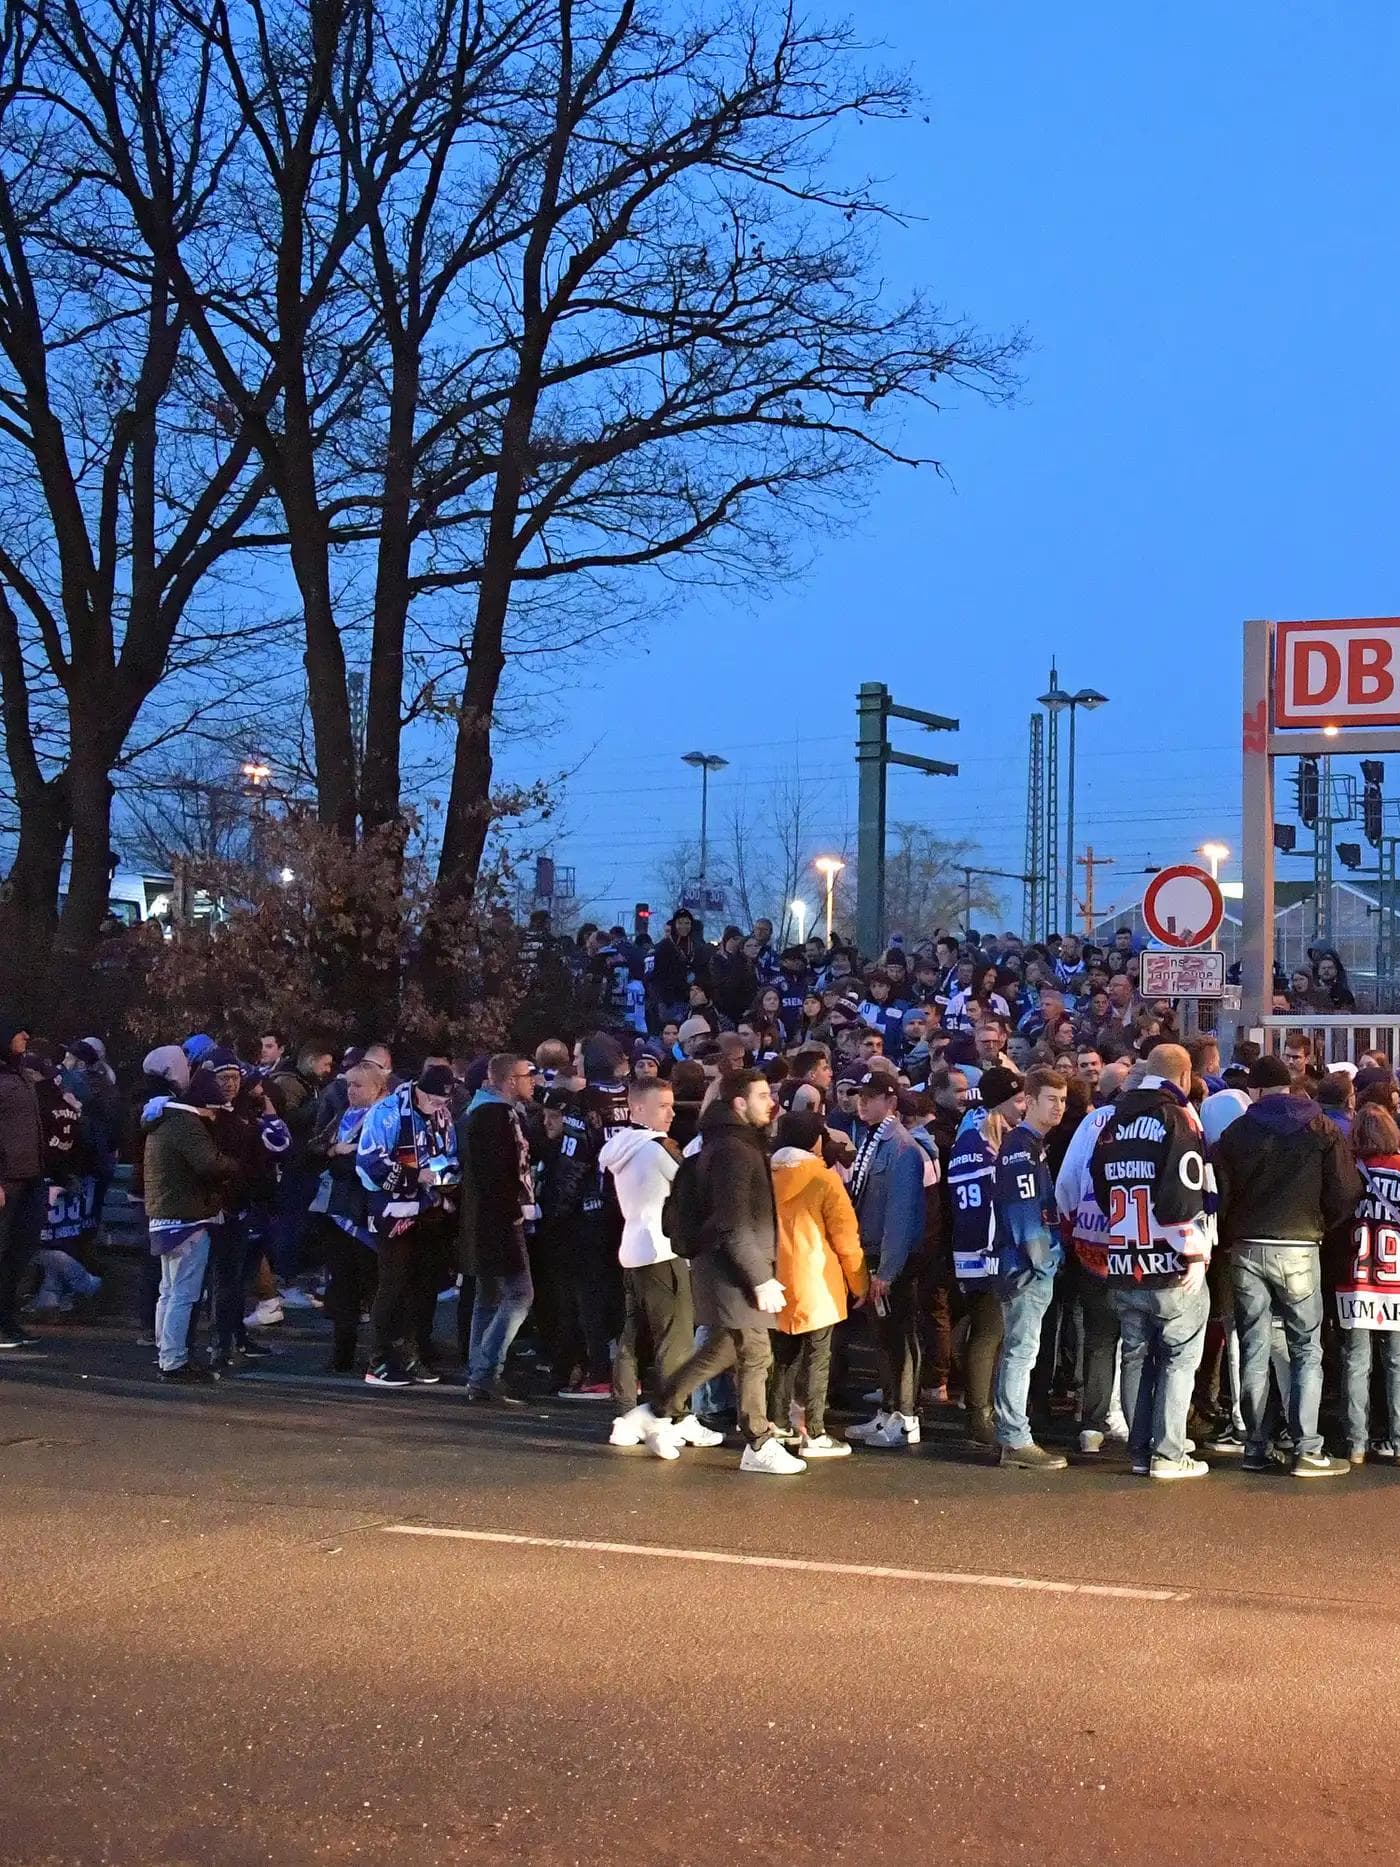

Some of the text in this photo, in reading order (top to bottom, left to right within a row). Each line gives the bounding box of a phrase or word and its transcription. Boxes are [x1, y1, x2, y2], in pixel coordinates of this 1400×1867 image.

[1292, 638, 1395, 706] DB
[948, 1153, 984, 1170] AIRBUS
[957, 1183, 982, 1210] 39
[1016, 1173, 1036, 1199] 51
[1108, 1185, 1154, 1250] 21
[1107, 1252, 1187, 1277] XMARK
